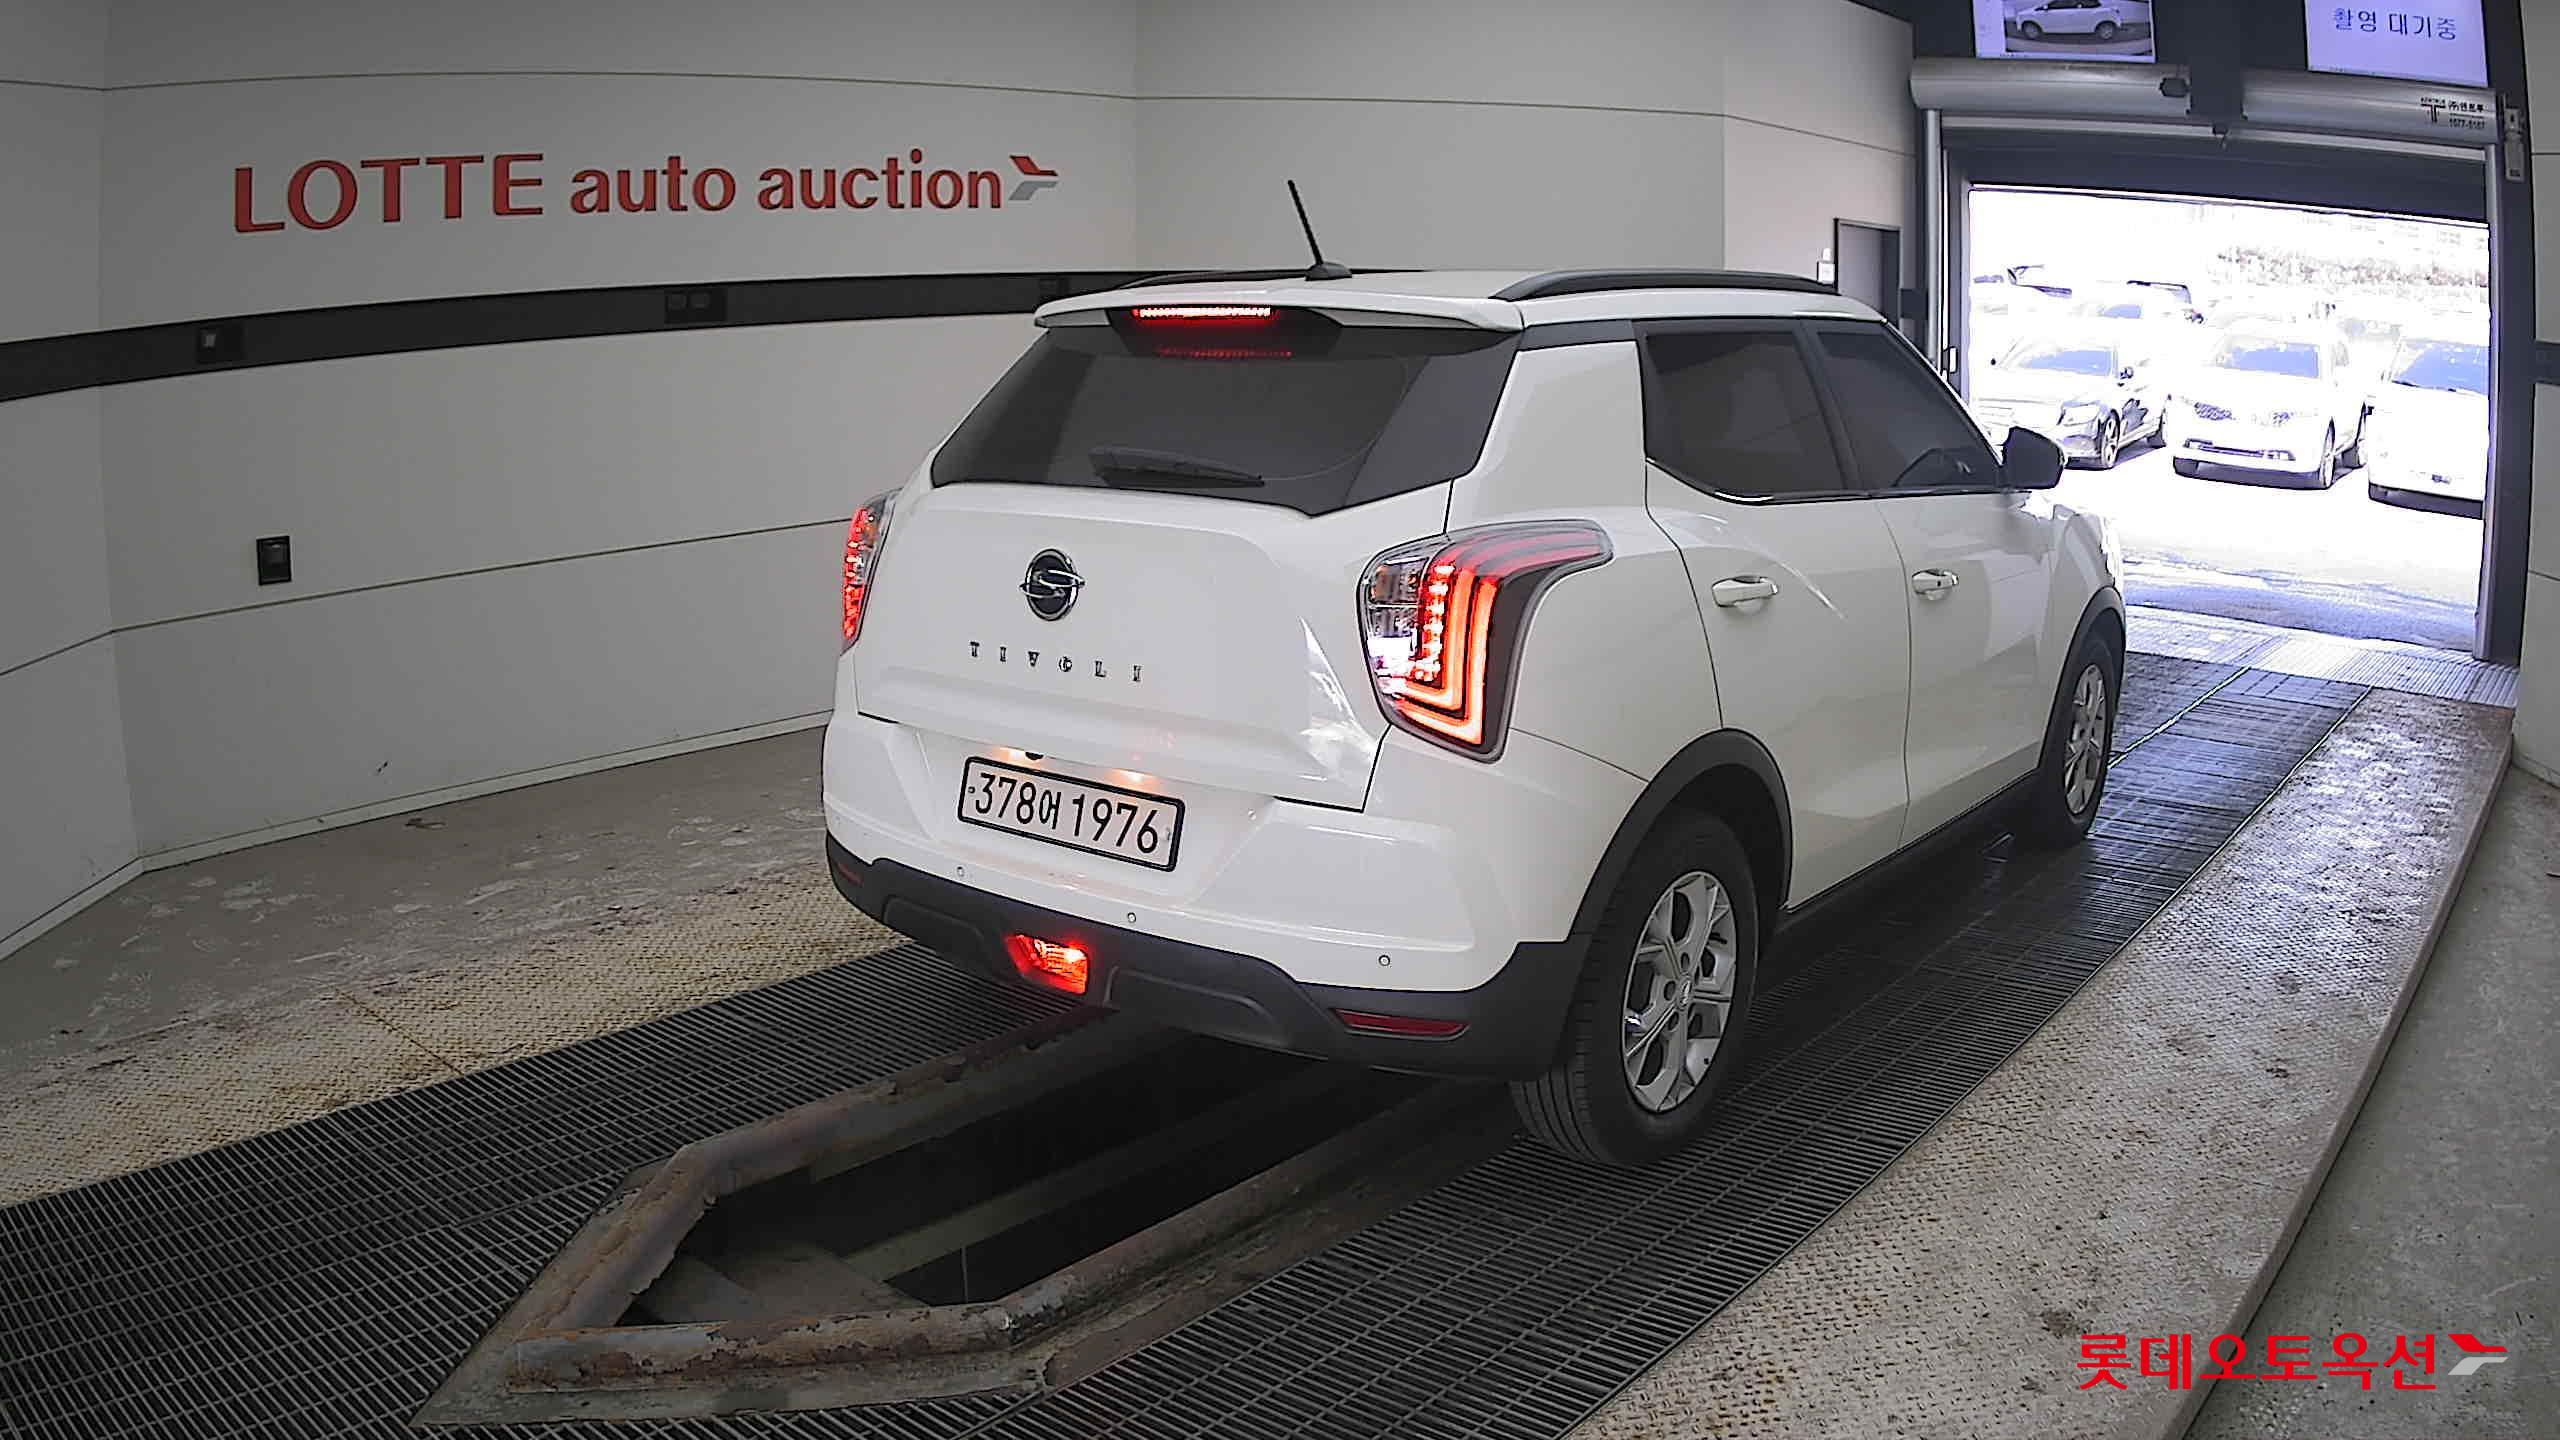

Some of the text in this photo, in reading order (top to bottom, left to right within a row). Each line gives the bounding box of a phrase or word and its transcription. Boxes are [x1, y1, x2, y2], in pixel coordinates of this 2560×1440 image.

[2387, 12, 2457, 41] 대기중
[233, 147, 1004, 233] LOTTE auto auction
[969, 640, 1143, 683] TIVOLI
